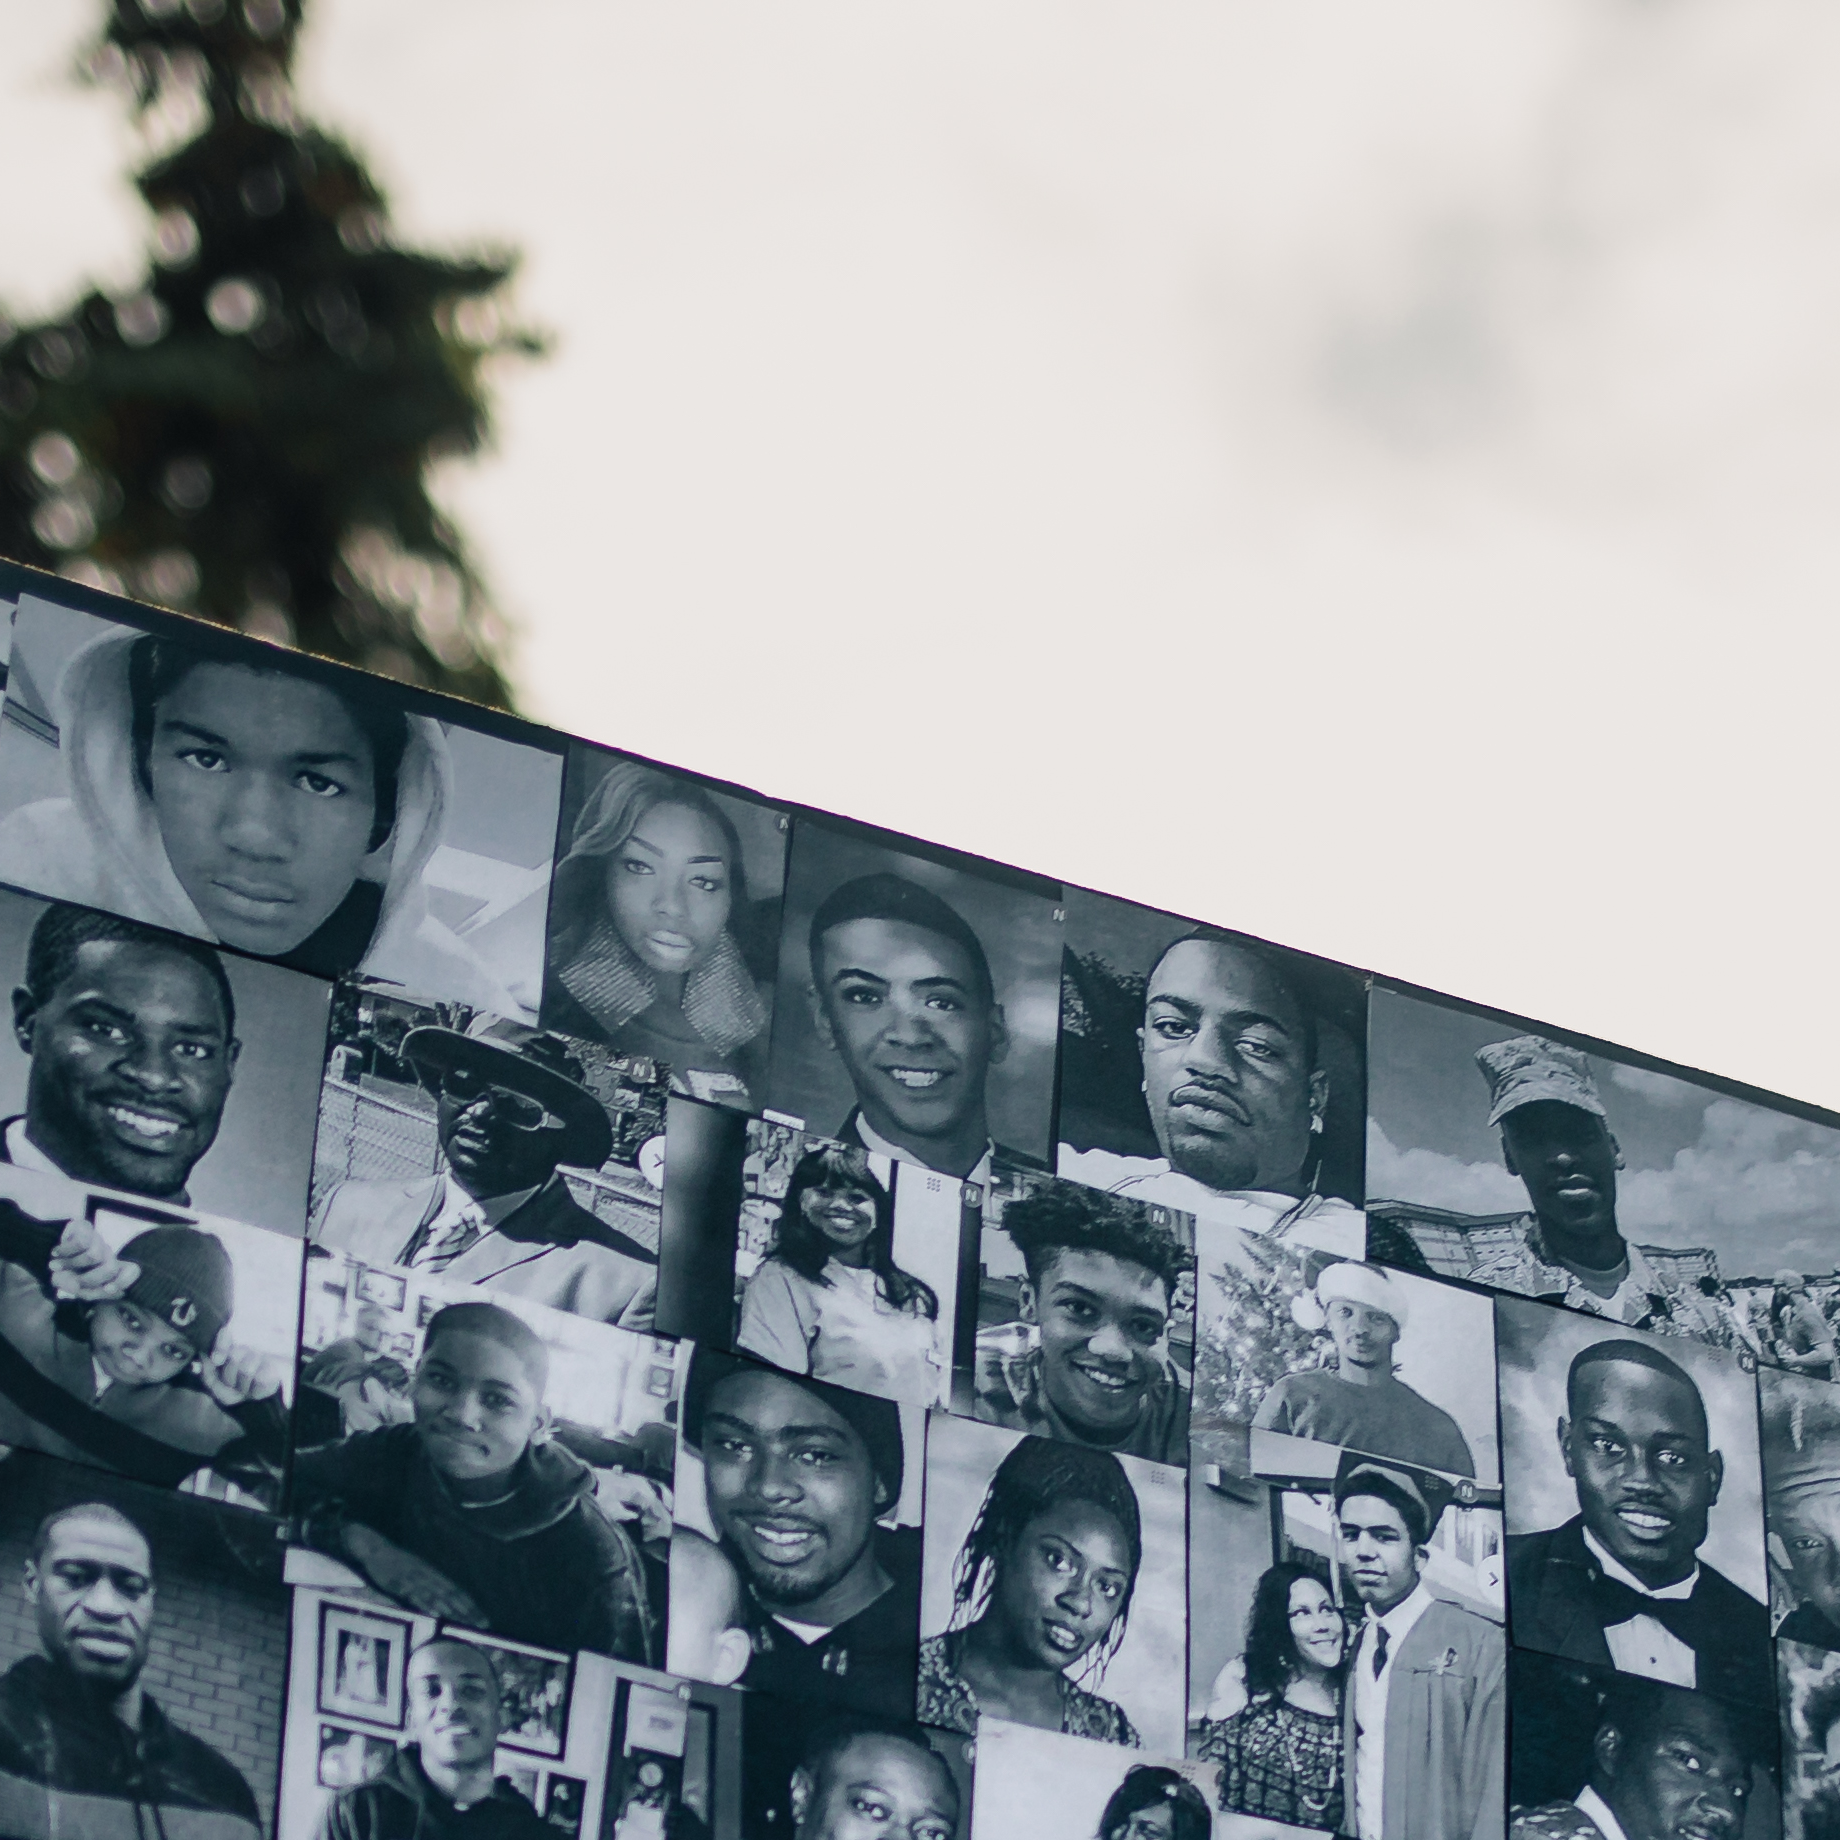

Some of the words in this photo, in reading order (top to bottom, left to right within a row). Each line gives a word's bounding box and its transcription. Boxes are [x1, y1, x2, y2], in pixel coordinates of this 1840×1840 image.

[633, 1062, 646, 1077] N
[965, 1188, 977, 1203] N
[1153, 1209, 1164, 1224] N
[1742, 1356, 1753, 1370] N
[1461, 1485, 1473, 1498] N
